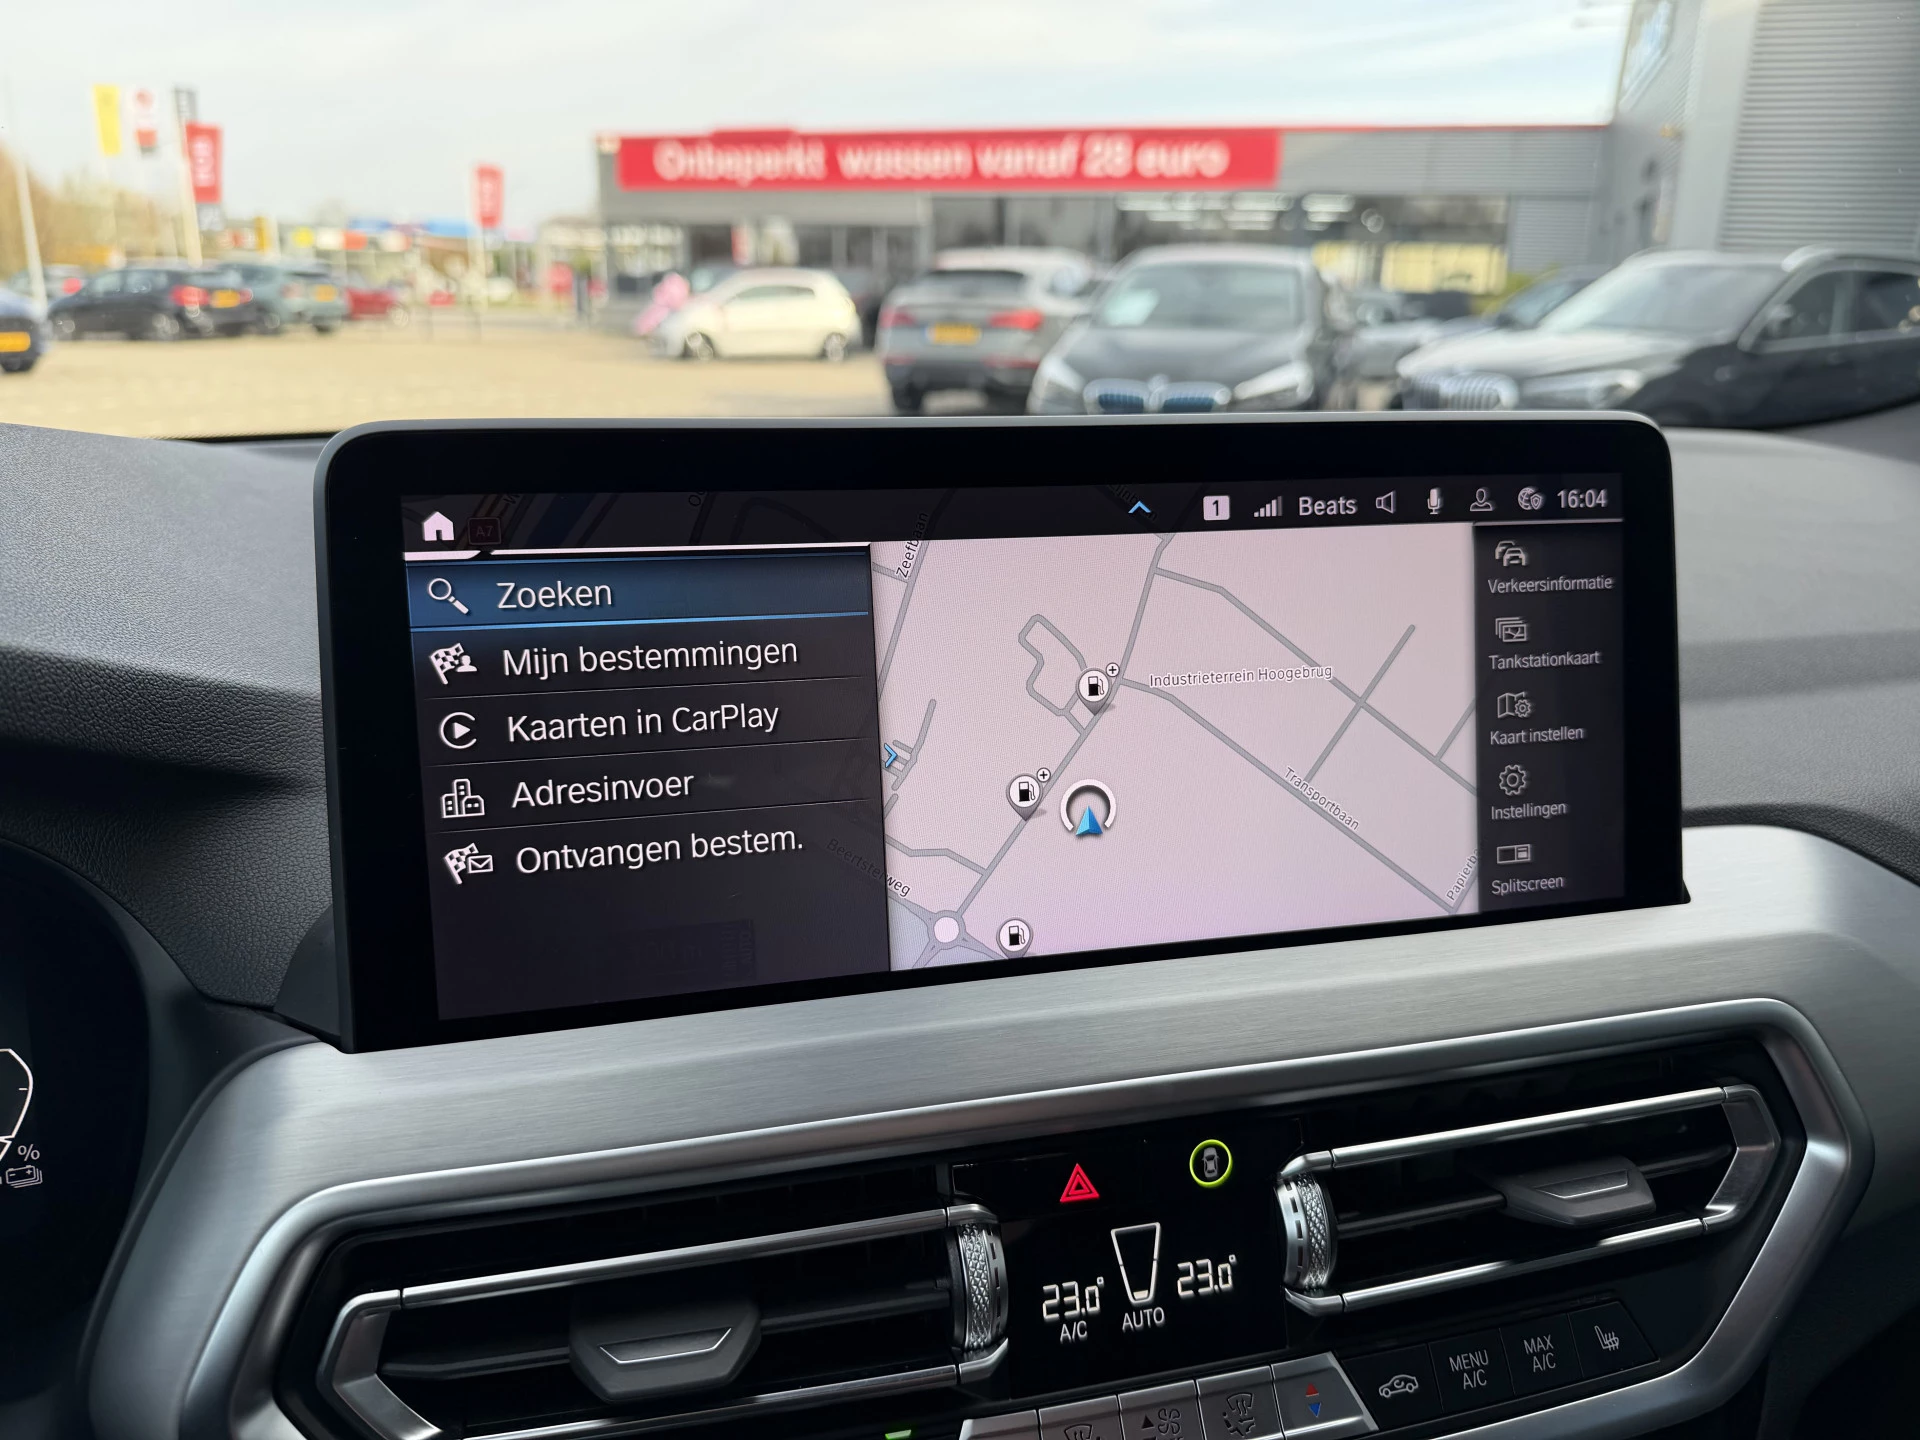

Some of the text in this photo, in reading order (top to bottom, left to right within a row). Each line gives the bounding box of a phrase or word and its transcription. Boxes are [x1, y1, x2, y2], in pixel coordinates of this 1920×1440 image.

[653, 133, 1231, 187] Onbeperkt wassen vanaf 28 euro
[1212, 499, 1220, 517] 1
[1298, 495, 1358, 517] Beats
[1556, 488, 1608, 509] 16:04
[895, 512, 929, 578] Zeefbaan
[496, 580, 612, 610] Zoeken
[1487, 574, 1615, 595] Verkeersinformatie
[502, 640, 798, 681] Mijn bestemmingen
[1488, 650, 1601, 671] Tankstationkaart
[1149, 666, 1333, 688] Industrieterrein Hoogebrug
[507, 702, 779, 743] Kaarten in CarPlay
[1490, 726, 1585, 745] Kaart instellen
[511, 771, 696, 809] Adresinvoer
[1285, 766, 1360, 831] Transportbaan
[1491, 801, 1567, 821] Instellingen
[516, 827, 803, 874] Ontvangen bestem.
[1491, 874, 1565, 896] Splitscreen
[1121, 1306, 1165, 1331] AUTO
[1059, 1319, 1088, 1342] A/C
[1523, 1334, 1555, 1355] MAX
[1449, 1349, 1489, 1373] MENU
[1532, 1352, 1556, 1373] A/C
[1462, 1369, 1488, 1390] A/C
